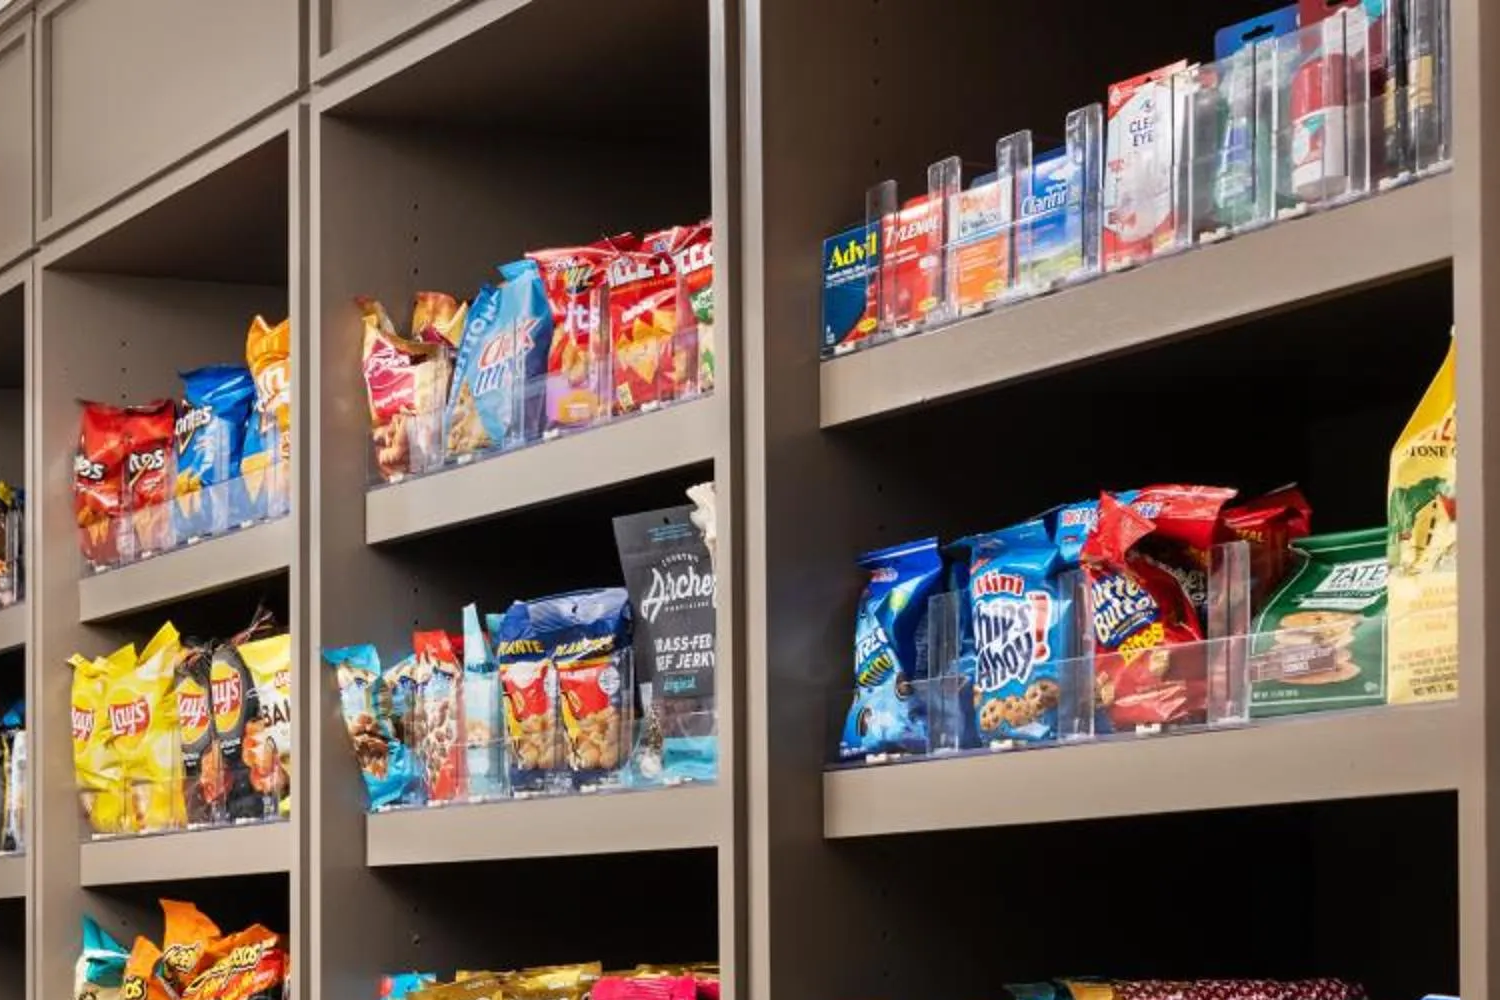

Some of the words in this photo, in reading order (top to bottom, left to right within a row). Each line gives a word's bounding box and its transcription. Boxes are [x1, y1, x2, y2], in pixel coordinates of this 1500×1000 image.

[828, 231, 877, 270] Advil
[1408, 446, 1446, 458] TONE
[977, 601, 1031, 645] hips
[654, 634, 713, 654] RASS-FED
